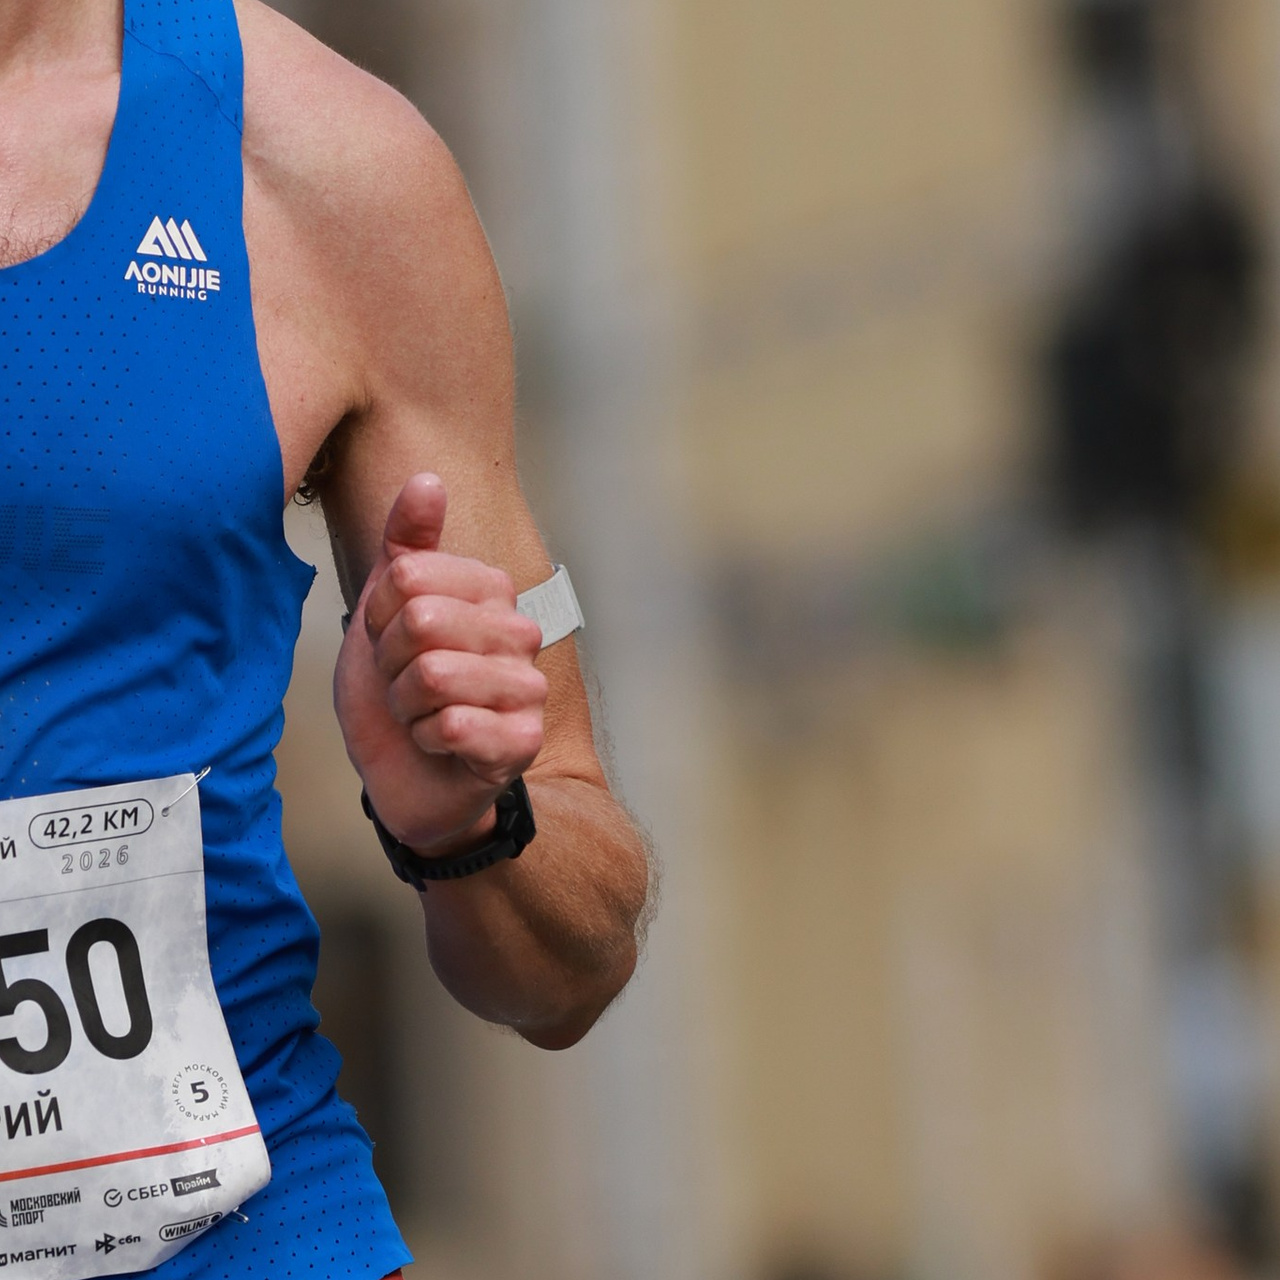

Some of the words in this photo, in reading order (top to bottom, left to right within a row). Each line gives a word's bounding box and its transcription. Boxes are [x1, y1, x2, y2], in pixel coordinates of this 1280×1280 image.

[124, 260, 220, 291] AONIJIE
[137, 282, 207, 301] RUNNING
[43, 813, 93, 839] 42,2
[103, 806, 139, 831] КМ
[61, 845, 129, 874] 2026
[184, 1064, 229, 1110] МОСКОВСКИЙ
[190, 1081, 209, 1103] 5
[174, 1099, 219, 1121] МАРАФОН
[10, 1187, 81, 1213] МОСКОВСКИЙ
[127, 1183, 169, 1201] СБЕР
[175, 1176, 211, 1192] Прайм
[11, 1209, 45, 1227] СПОРТ
[164, 1218, 210, 1238] WINLINE
[118, 1234, 141, 1245] сбп
